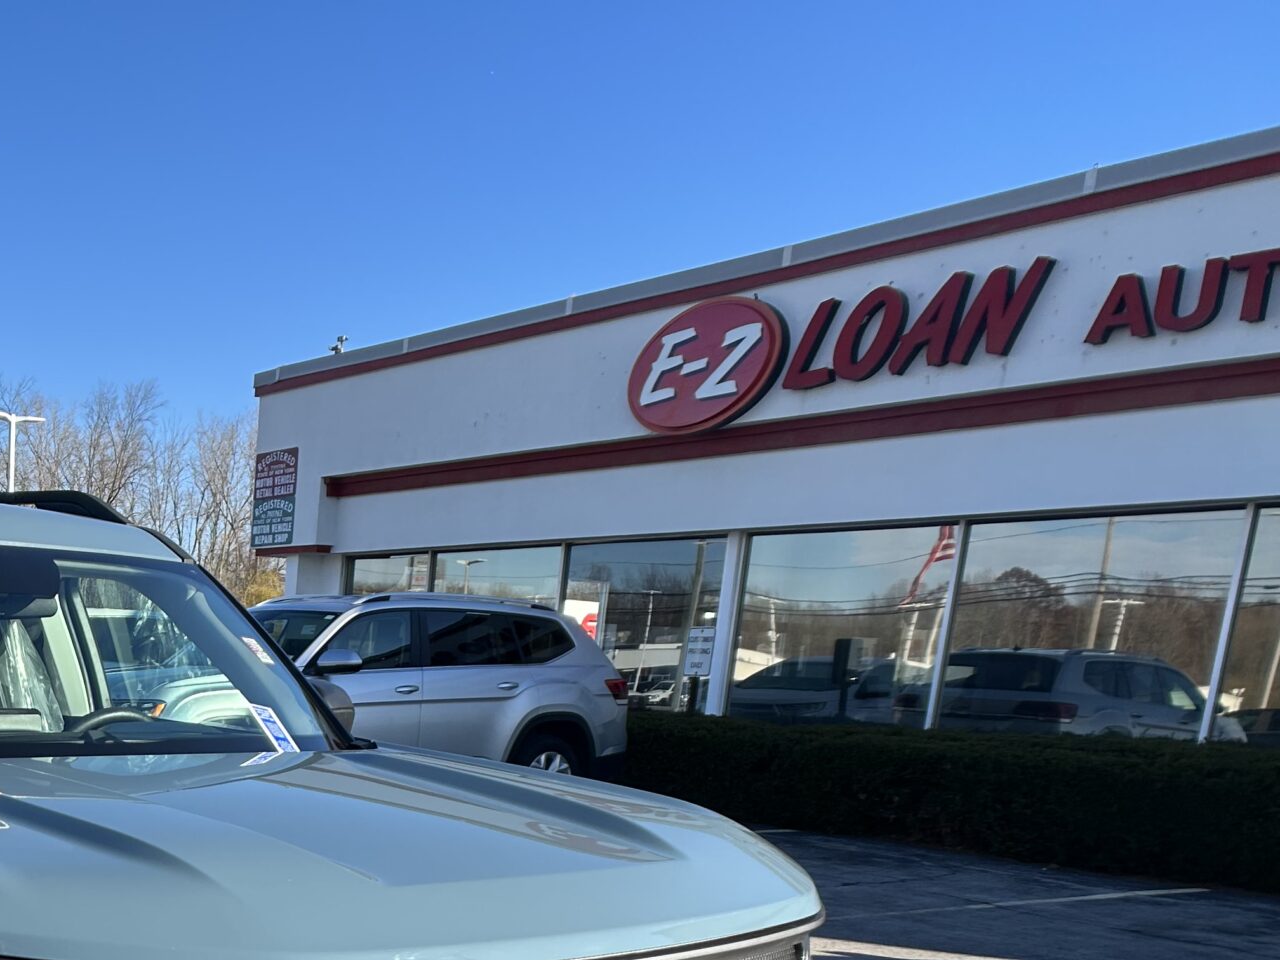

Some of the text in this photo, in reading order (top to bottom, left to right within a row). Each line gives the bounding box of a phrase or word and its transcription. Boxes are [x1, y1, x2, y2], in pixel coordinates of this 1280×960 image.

[639, 248, 1280, 408] E-Z LOAN AUT
[257, 451, 296, 472] REGISTERED
[255, 473, 296, 488] MOTOR VEHICLE
[255, 484, 294, 499] RETAIL DEALER
[254, 499, 294, 517] REGISTERED
[252, 522, 293, 535] MOTOR VEHICLE
[254, 533, 289, 545] REPAIR SHOP
